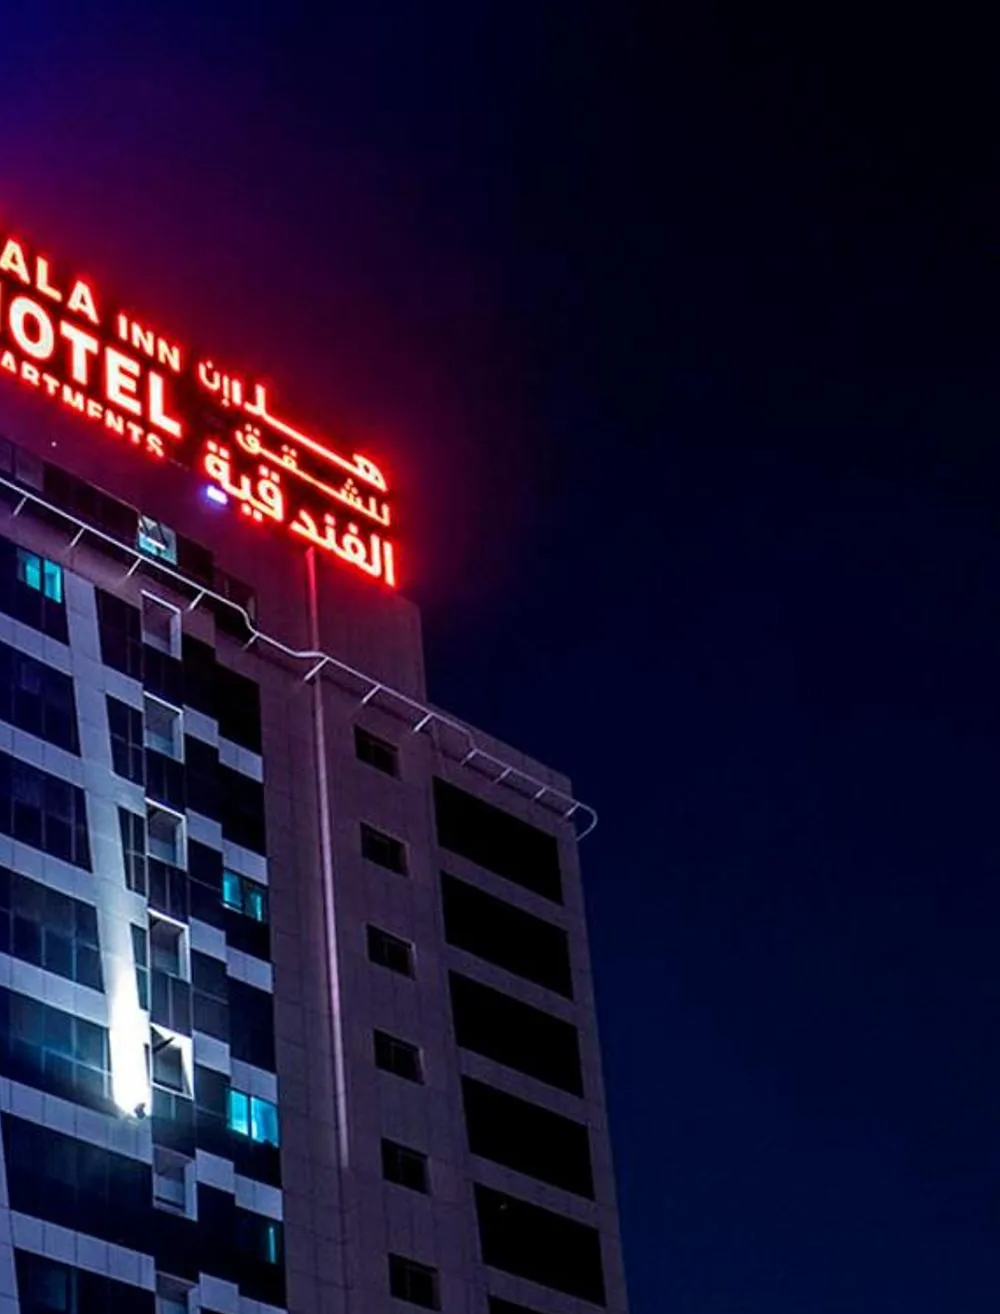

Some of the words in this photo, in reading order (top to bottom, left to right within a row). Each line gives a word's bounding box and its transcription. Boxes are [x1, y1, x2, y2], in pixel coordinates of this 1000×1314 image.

[118, 313, 180, 372] INN
[204, 439, 395, 587] الفندقية
[235, 423, 390, 526] للشقق
